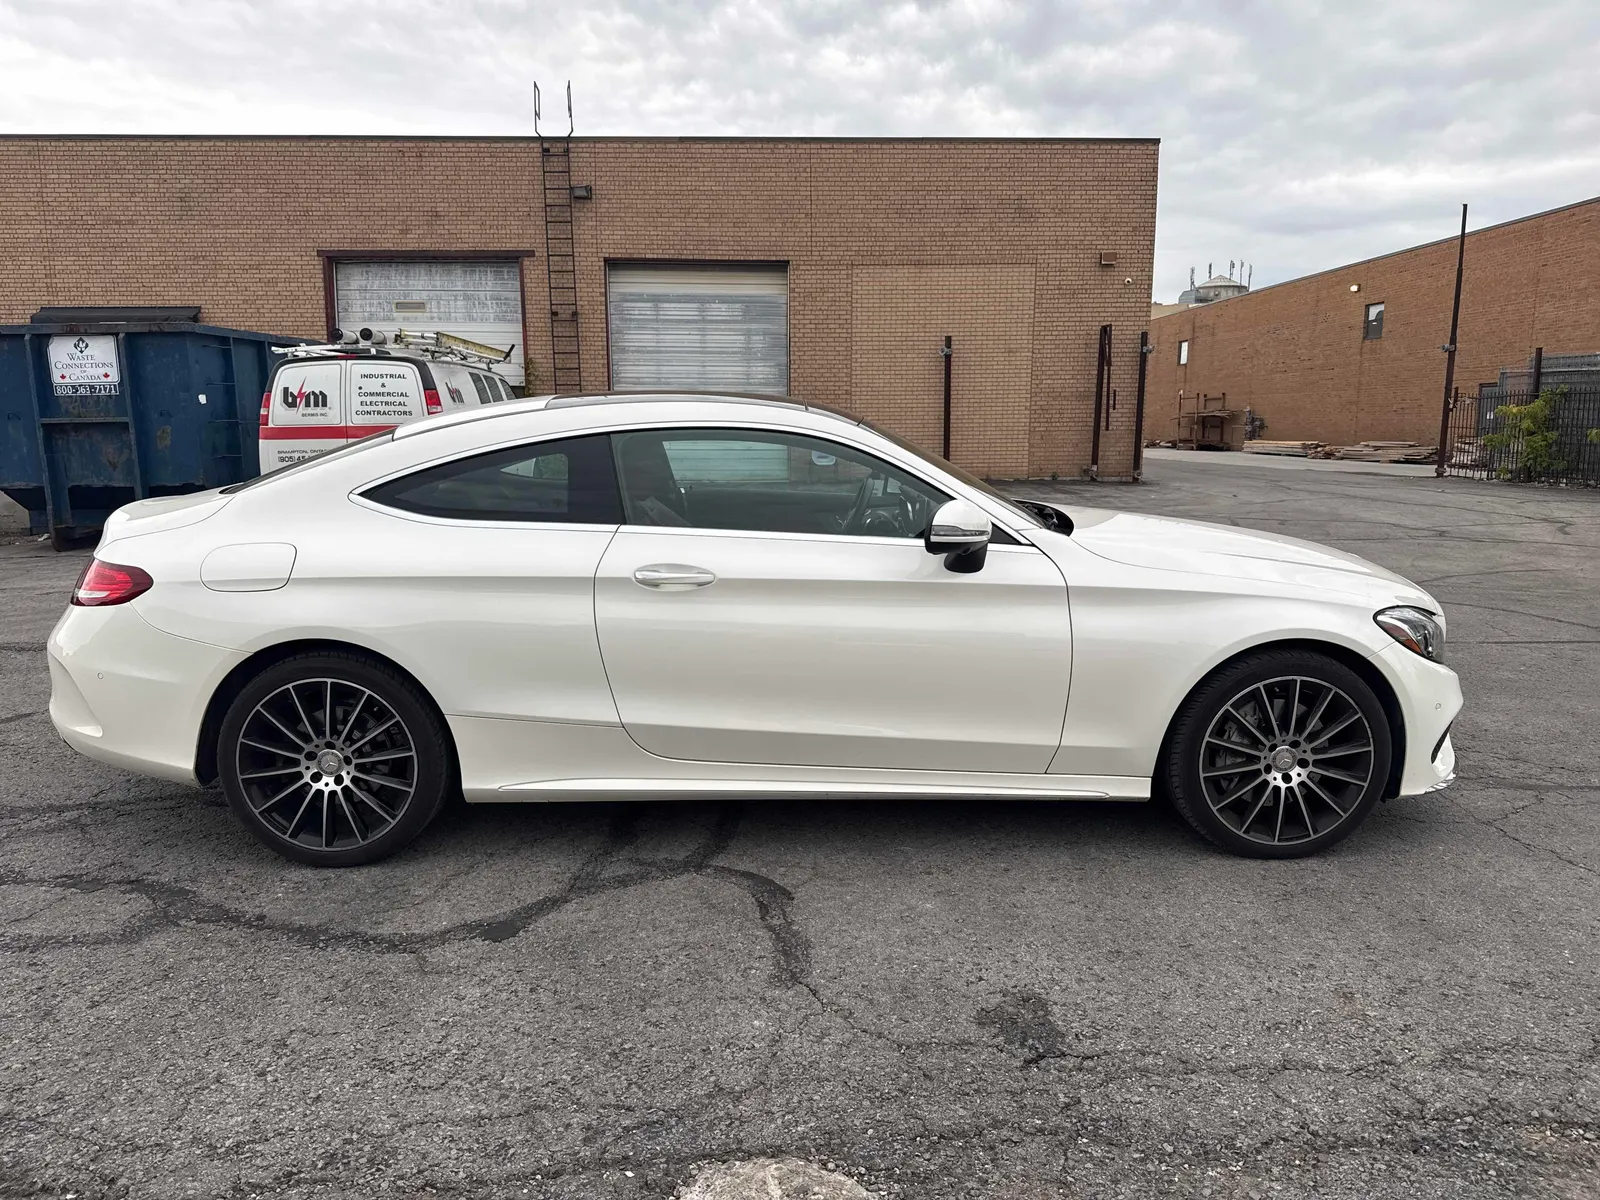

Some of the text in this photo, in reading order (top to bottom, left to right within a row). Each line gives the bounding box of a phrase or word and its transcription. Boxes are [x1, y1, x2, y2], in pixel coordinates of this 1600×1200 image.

[67, 353, 95, 361] WASTE
[54, 361, 114, 370] CONNECTIONS
[69, 373, 101, 381] CANADA
